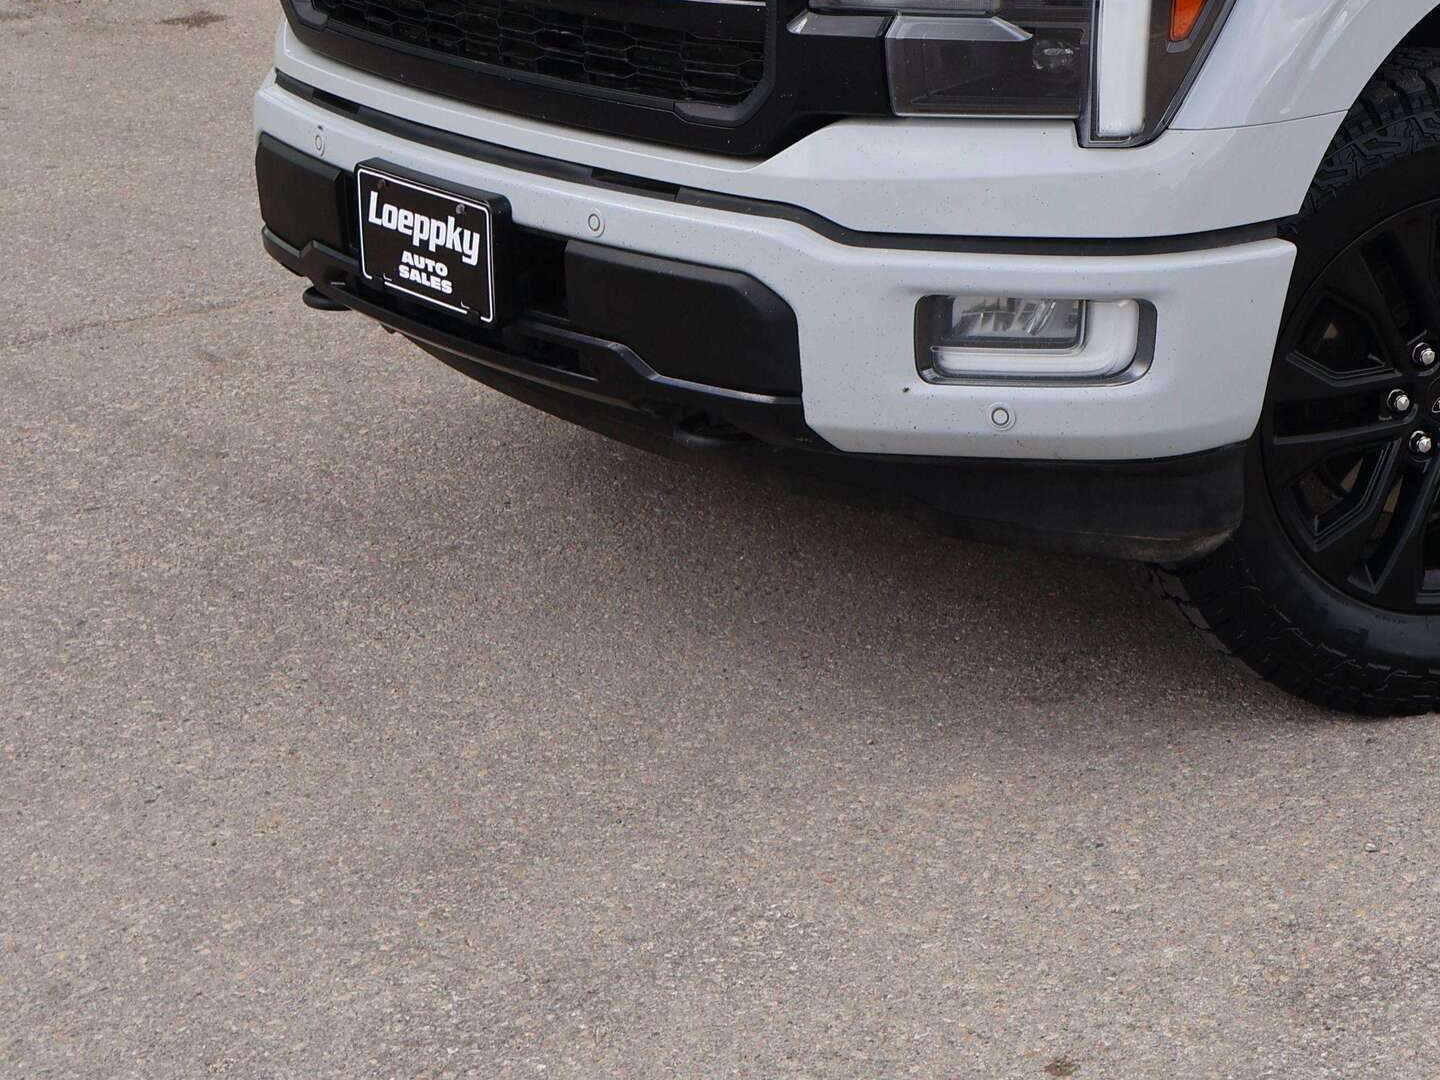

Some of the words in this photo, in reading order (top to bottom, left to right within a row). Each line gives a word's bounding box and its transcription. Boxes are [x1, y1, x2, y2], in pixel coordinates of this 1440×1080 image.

[368, 191, 480, 266] Loeppky
[401, 250, 448, 277] AUTO
[398, 265, 453, 294] SALES
